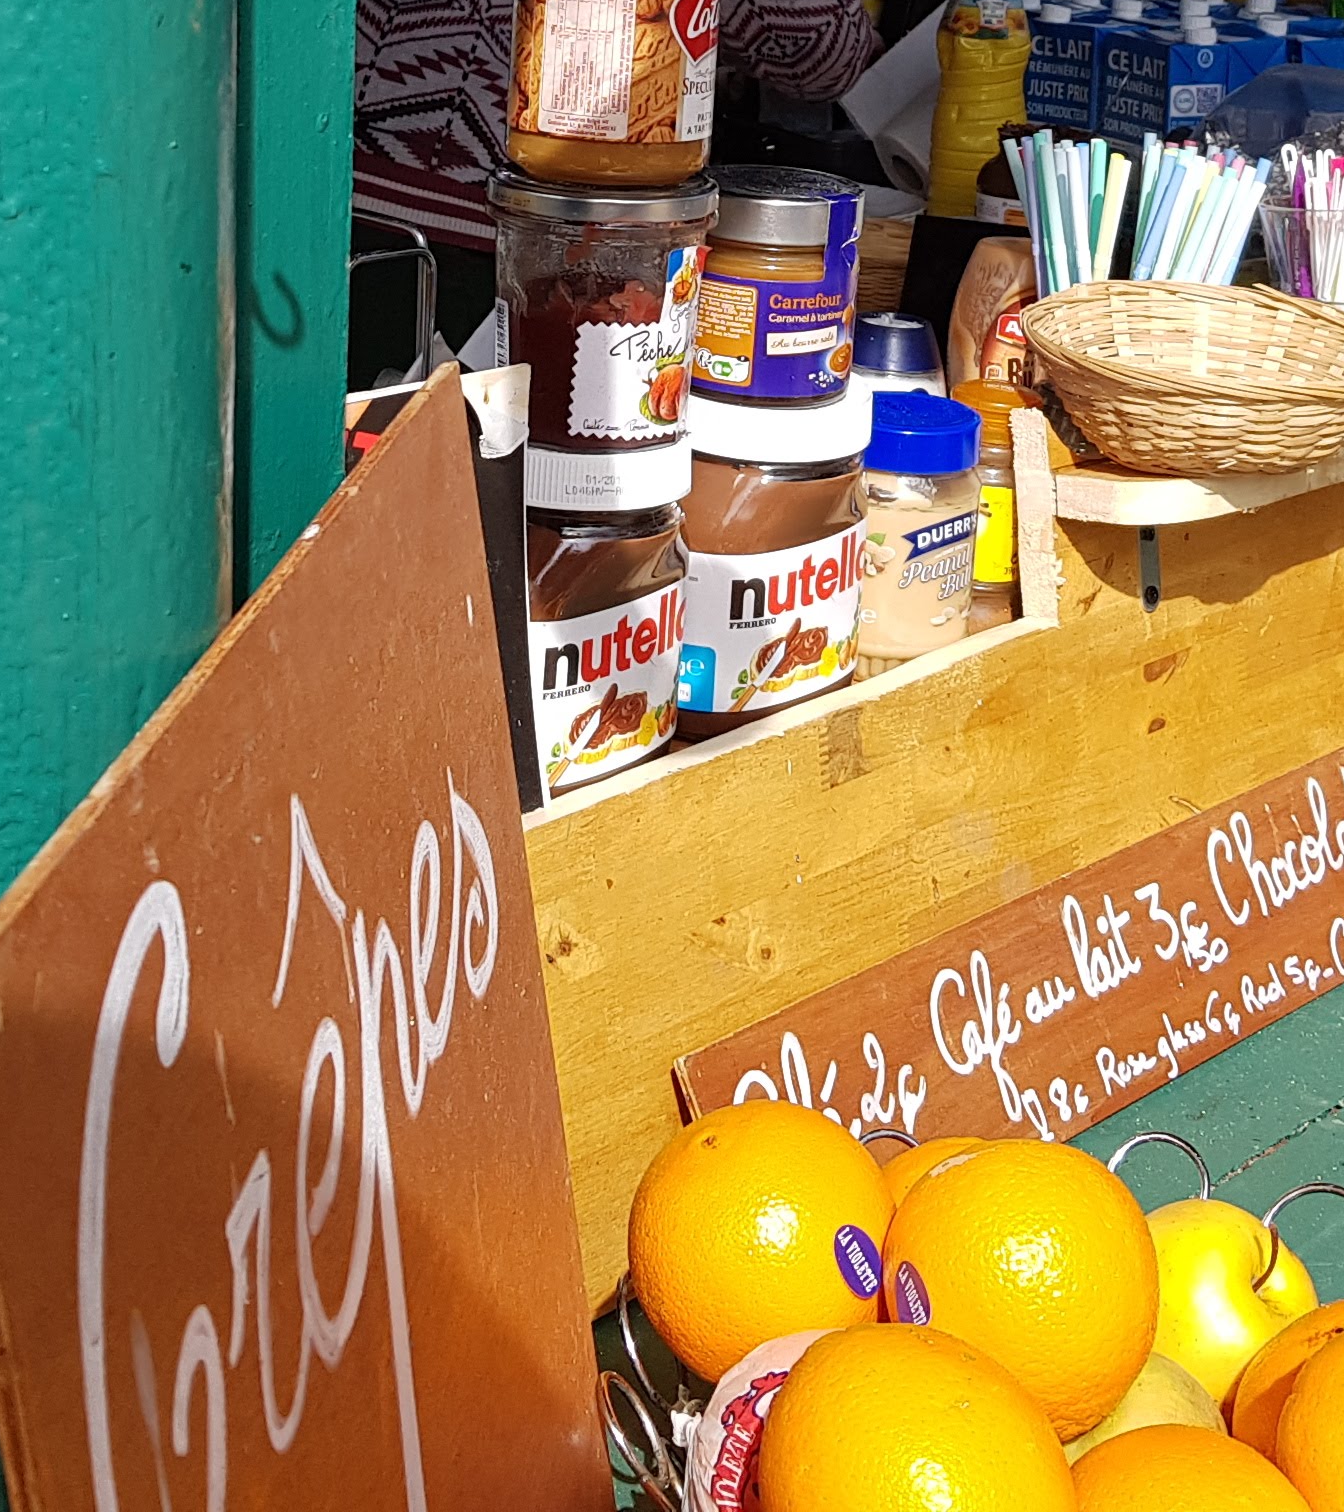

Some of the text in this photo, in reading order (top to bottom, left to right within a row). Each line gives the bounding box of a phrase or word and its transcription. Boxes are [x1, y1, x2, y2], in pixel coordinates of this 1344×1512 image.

[1032, 35, 1092, 61] CE LAIT
[1108, 48, 1166, 80] CE LAIT
[1027, 79, 1089, 103] JUSTE PRIX
[1107, 94, 1139, 117] JUSTE
[769, 293, 842, 310] Carrefour
[768, 311, 808, 323] Caramel
[609, 330, 682, 362] Pêche
[728, 617, 777, 630] FERRERO
[542, 685, 591, 701] FERRERO
[1241, 962, 1287, 1014] Red
[929, 949, 1022, 1121] Café
[1025, 976, 1076, 1024] au
[1062, 894, 1142, 999] lait
[77, 766, 499, 1512] Crêpes
[837, 1226, 878, 1293] LA VIOLETTE
[898, 1263, 910, 1286] LA
